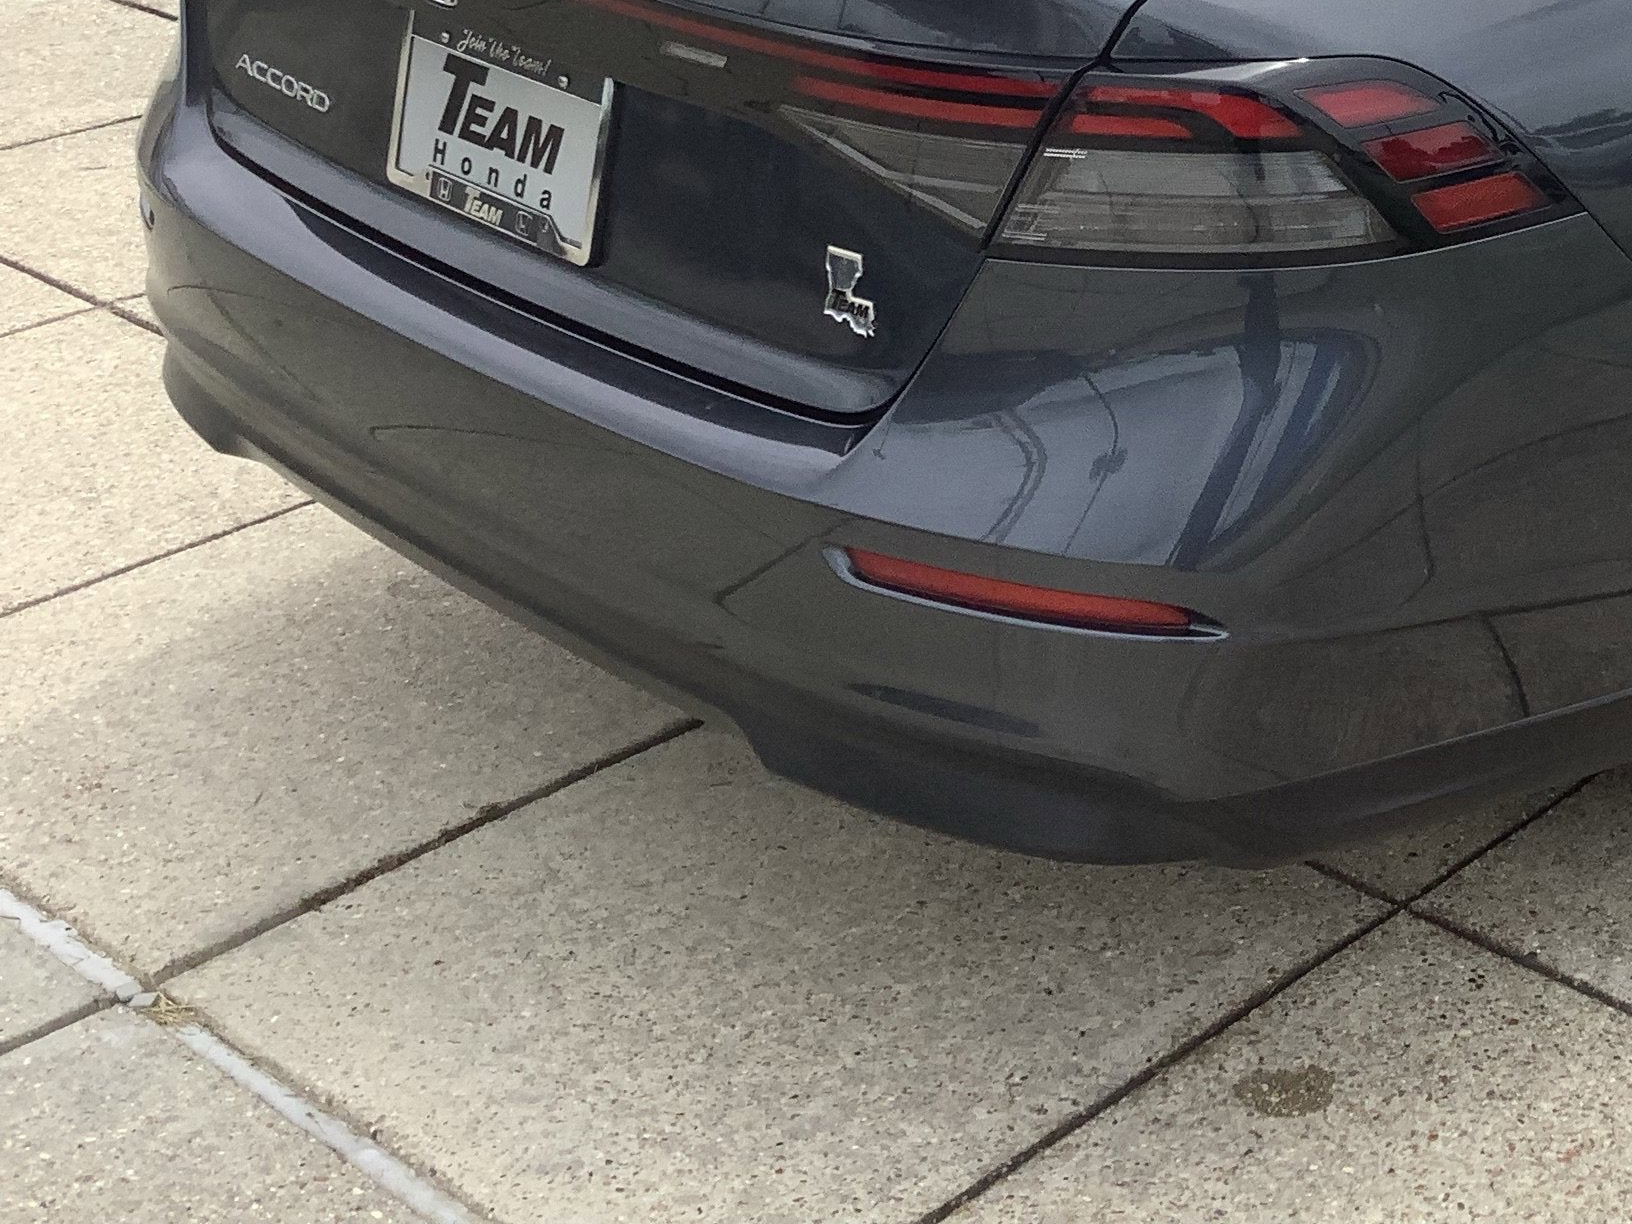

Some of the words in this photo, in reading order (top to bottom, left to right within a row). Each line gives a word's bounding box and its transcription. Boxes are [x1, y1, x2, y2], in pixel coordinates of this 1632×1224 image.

[456, 28, 487, 53] Join
[235, 53, 330, 113] ACCORD
[437, 52, 565, 175] TEAM
[432, 138, 553, 210] Honda
[463, 187, 504, 226] TEAM
